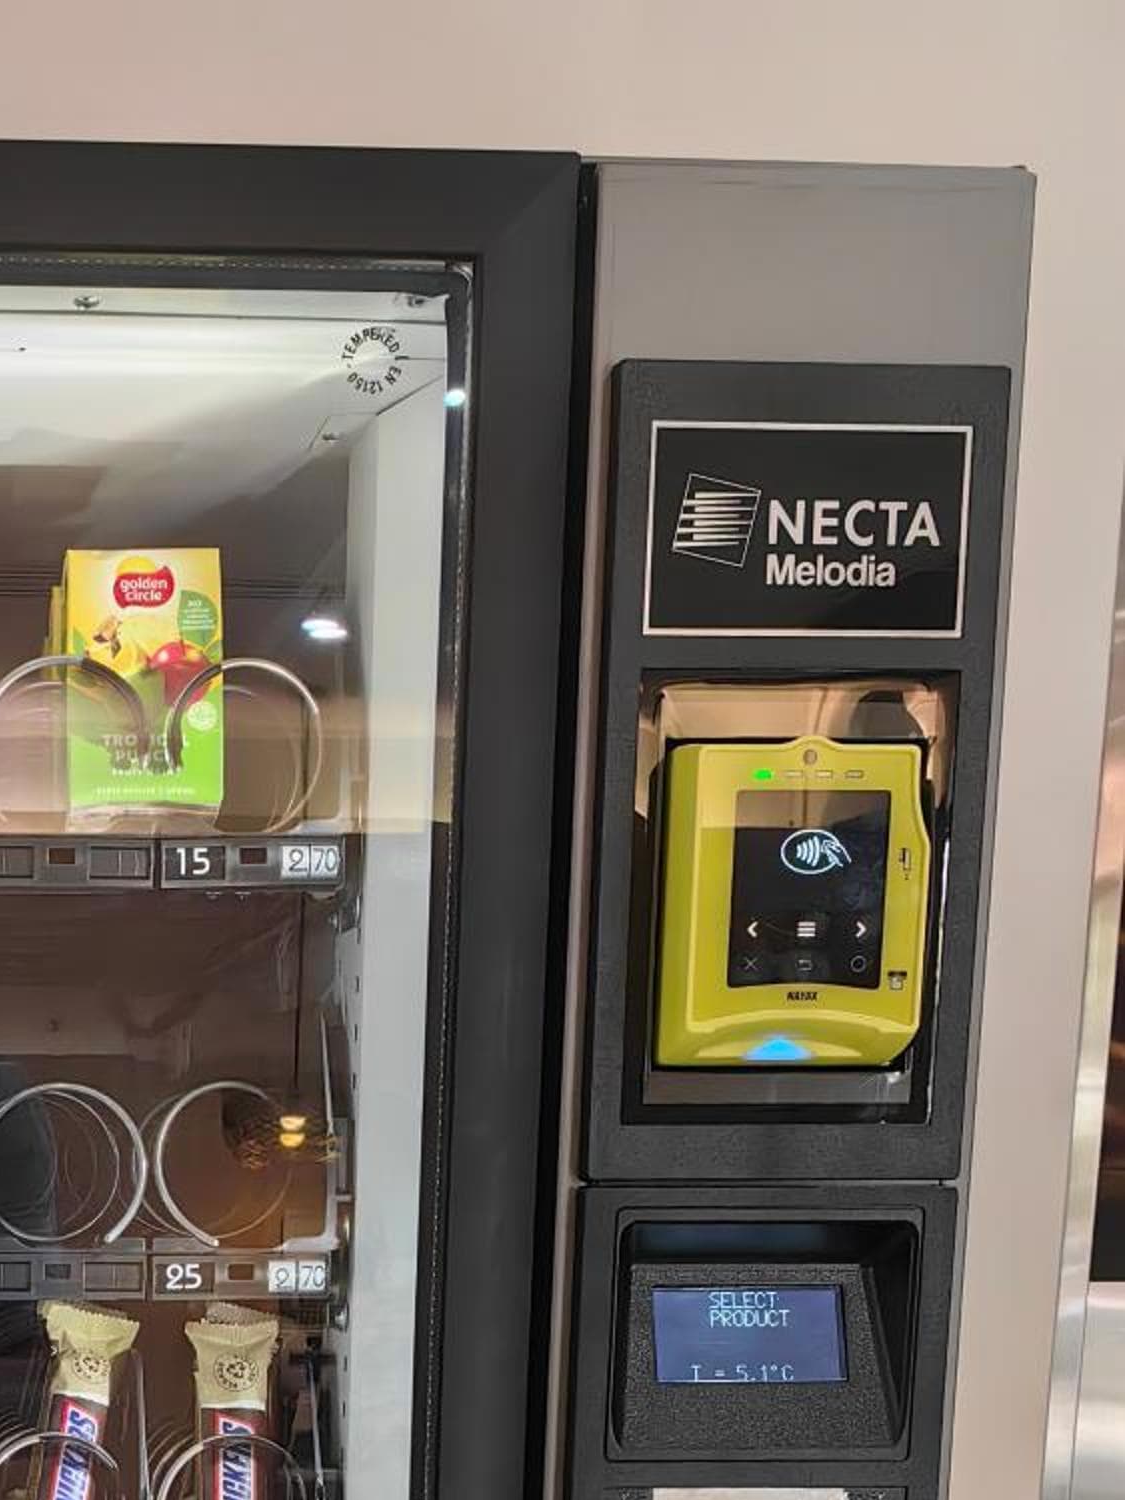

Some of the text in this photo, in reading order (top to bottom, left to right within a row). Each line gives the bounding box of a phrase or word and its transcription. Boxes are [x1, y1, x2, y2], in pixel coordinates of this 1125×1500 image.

[767, 499, 941, 547] NECTA
[766, 553, 897, 587] Melodia
[119, 577, 168, 593] golden
[125, 590, 163, 601] circle
[176, 847, 211, 875] 15
[165, 1263, 203, 1289] 25
[708, 1291, 778, 1309] SELECT
[709, 1310, 790, 1328] PRODUCT
[690, 1364, 701, 1382] T
